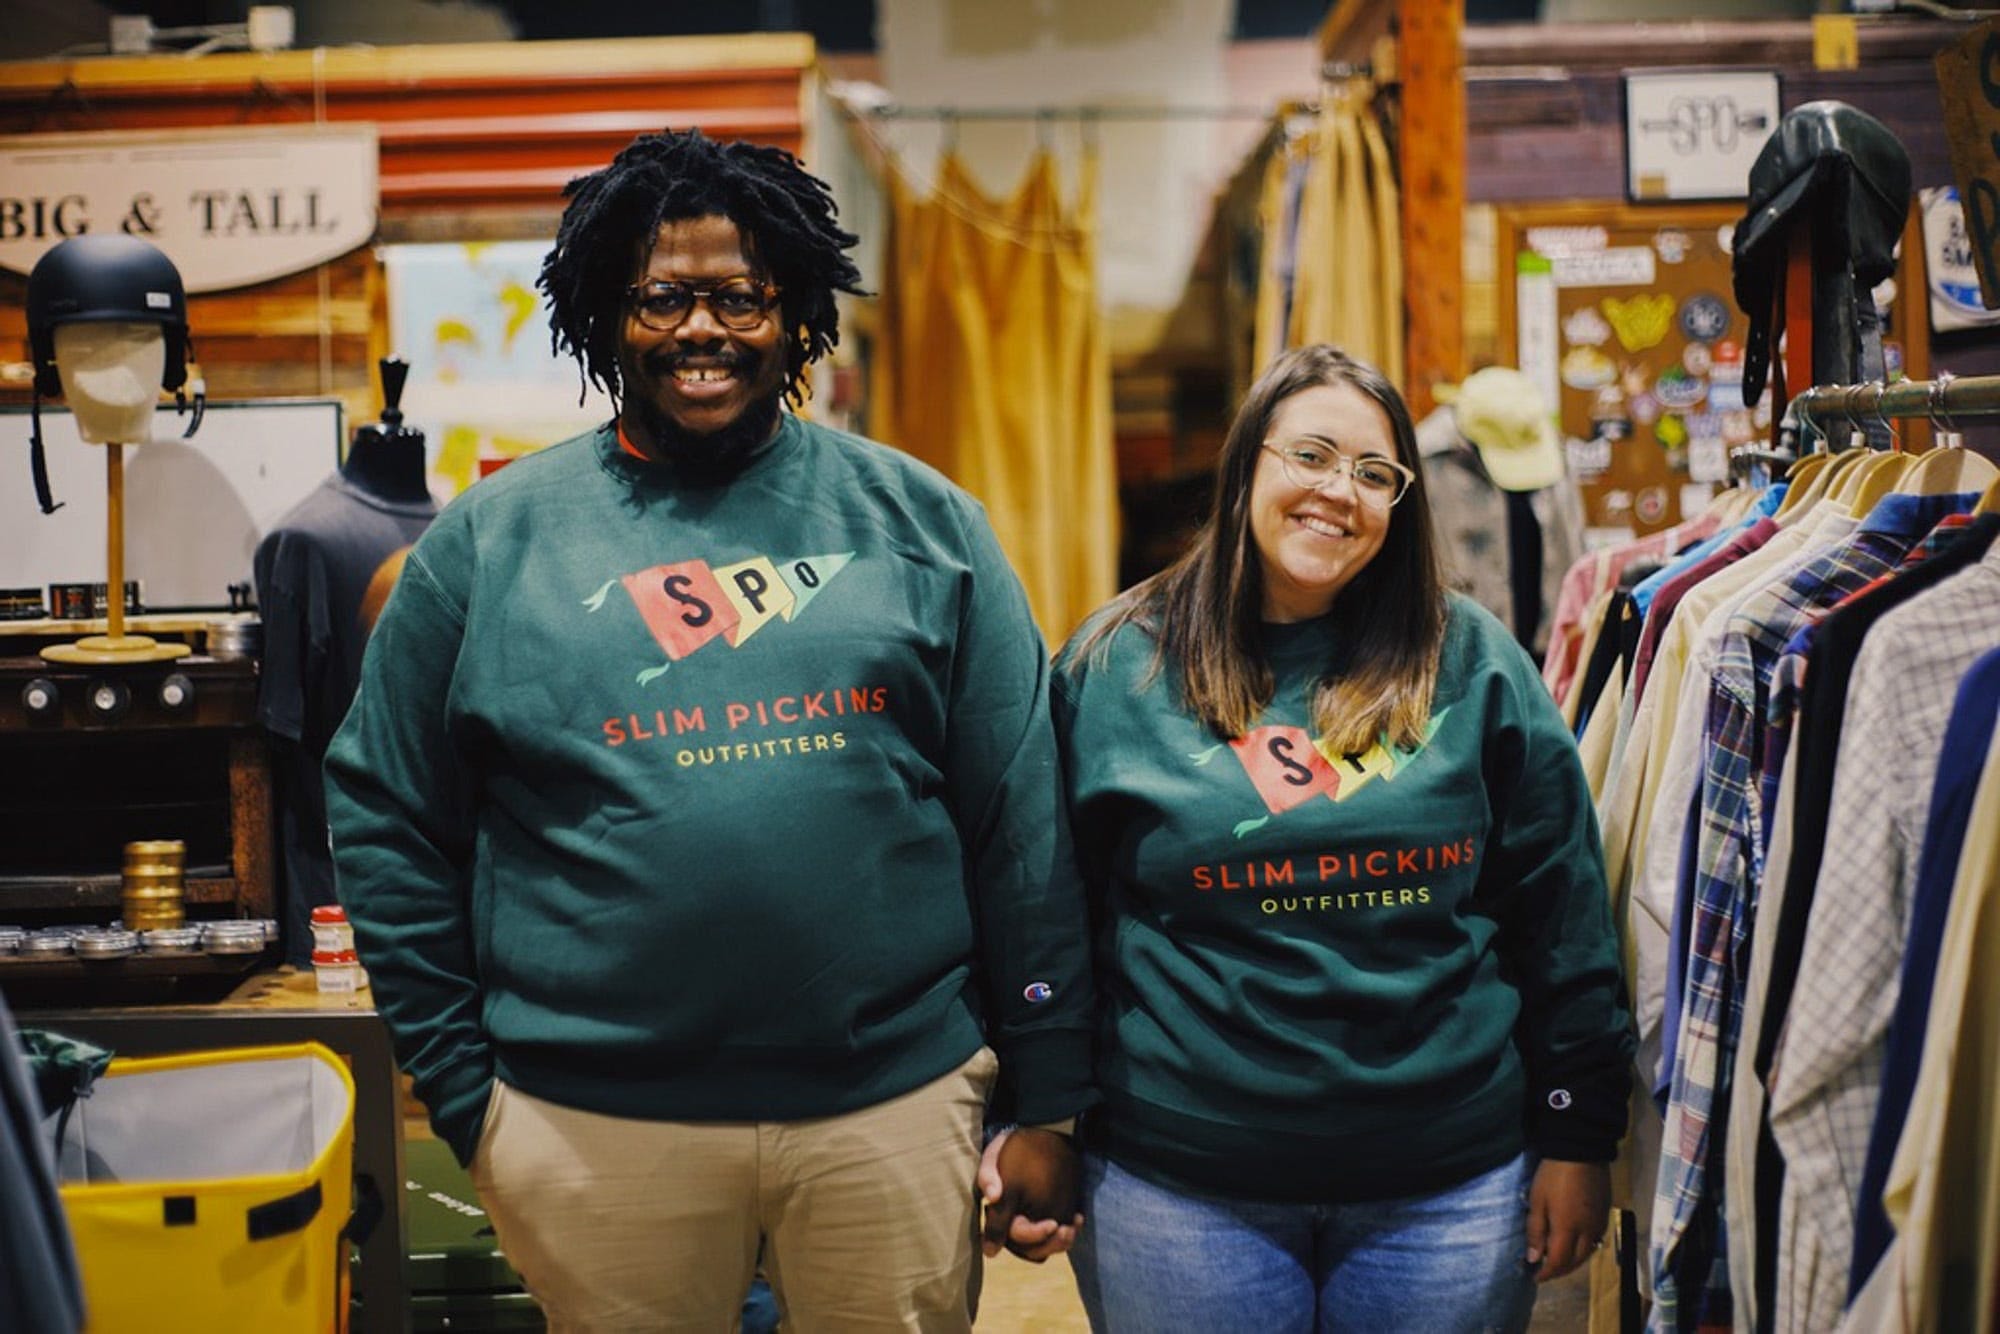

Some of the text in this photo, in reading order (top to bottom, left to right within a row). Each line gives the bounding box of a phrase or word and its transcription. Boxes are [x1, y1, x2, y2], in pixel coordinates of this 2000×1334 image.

[0, 186, 339, 239] BIG & TALL
[602, 687, 888, 746] SLIM PICKINS
[675, 731, 847, 767] OUTFITTERS
[1192, 837, 1476, 891] SLIM PICKINS
[1261, 886, 1432, 915] OUTFITTERS
